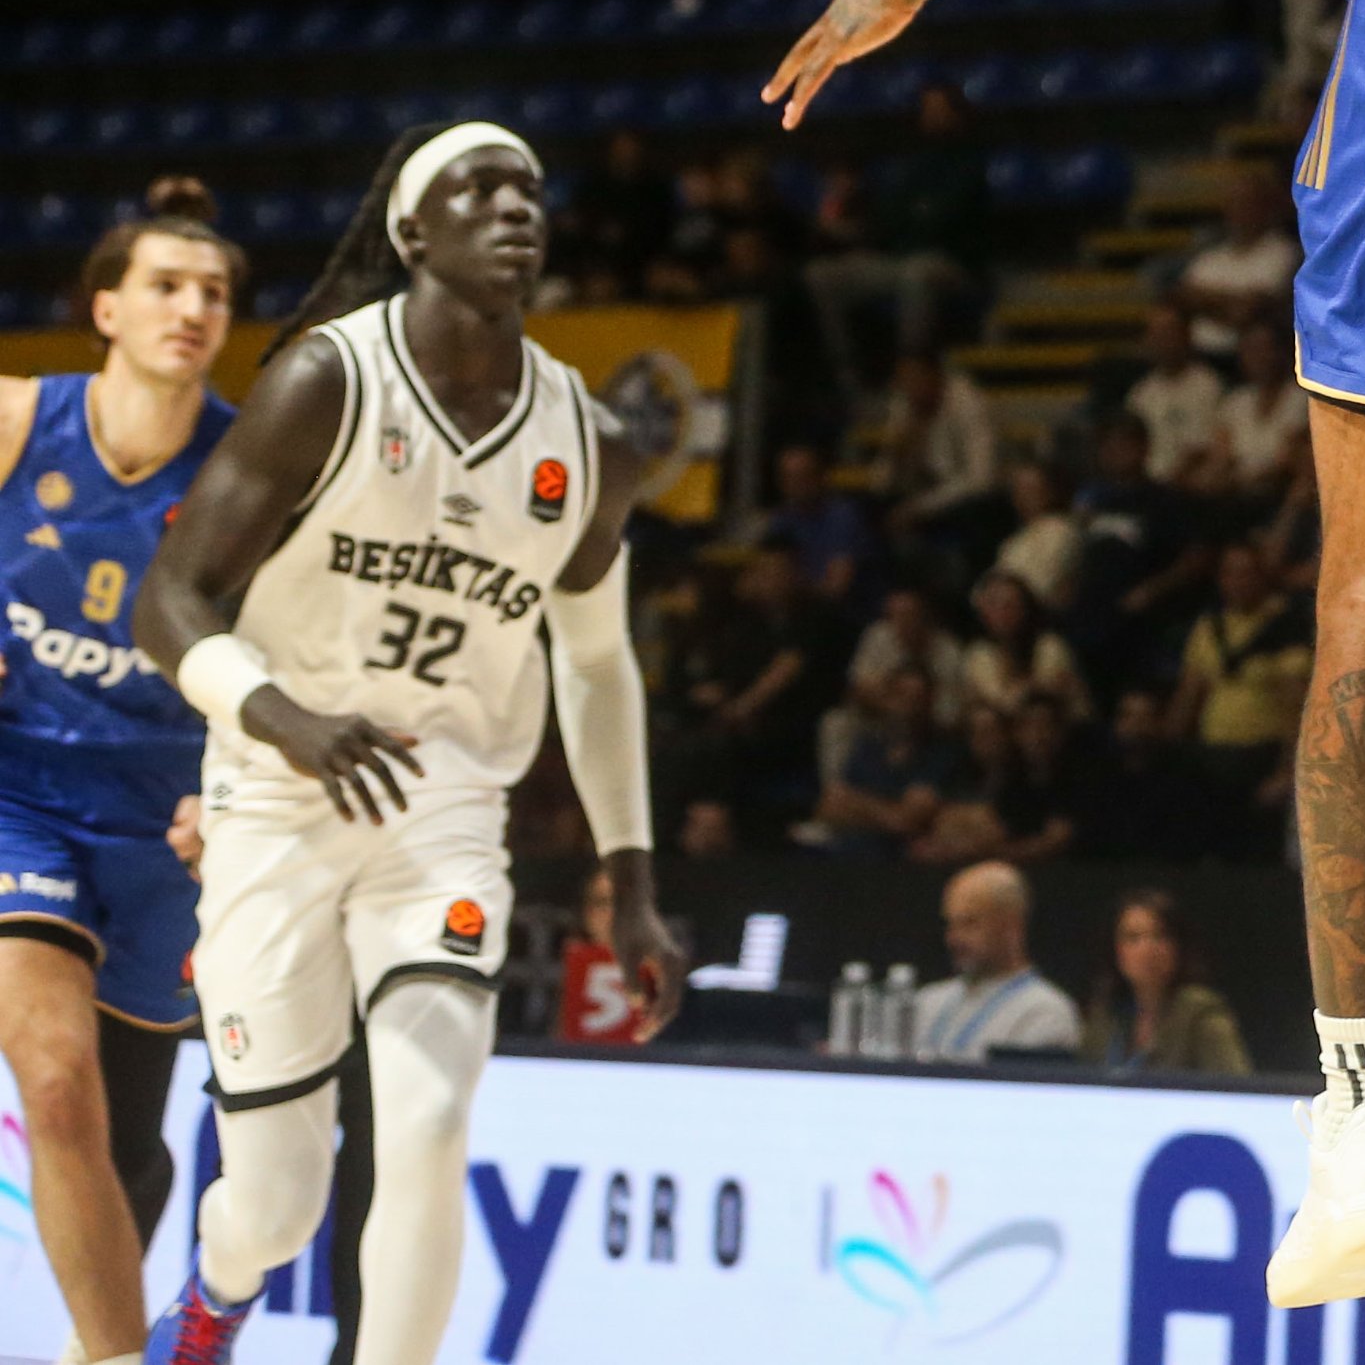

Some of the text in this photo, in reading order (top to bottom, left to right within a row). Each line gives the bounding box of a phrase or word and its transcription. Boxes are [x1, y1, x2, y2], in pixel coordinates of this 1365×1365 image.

[82, 559, 128, 624] 9
[328, 531, 542, 623] BEŞİKTAŞ
[363, 600, 467, 687] 32
[580, 962, 629, 1032] 5
